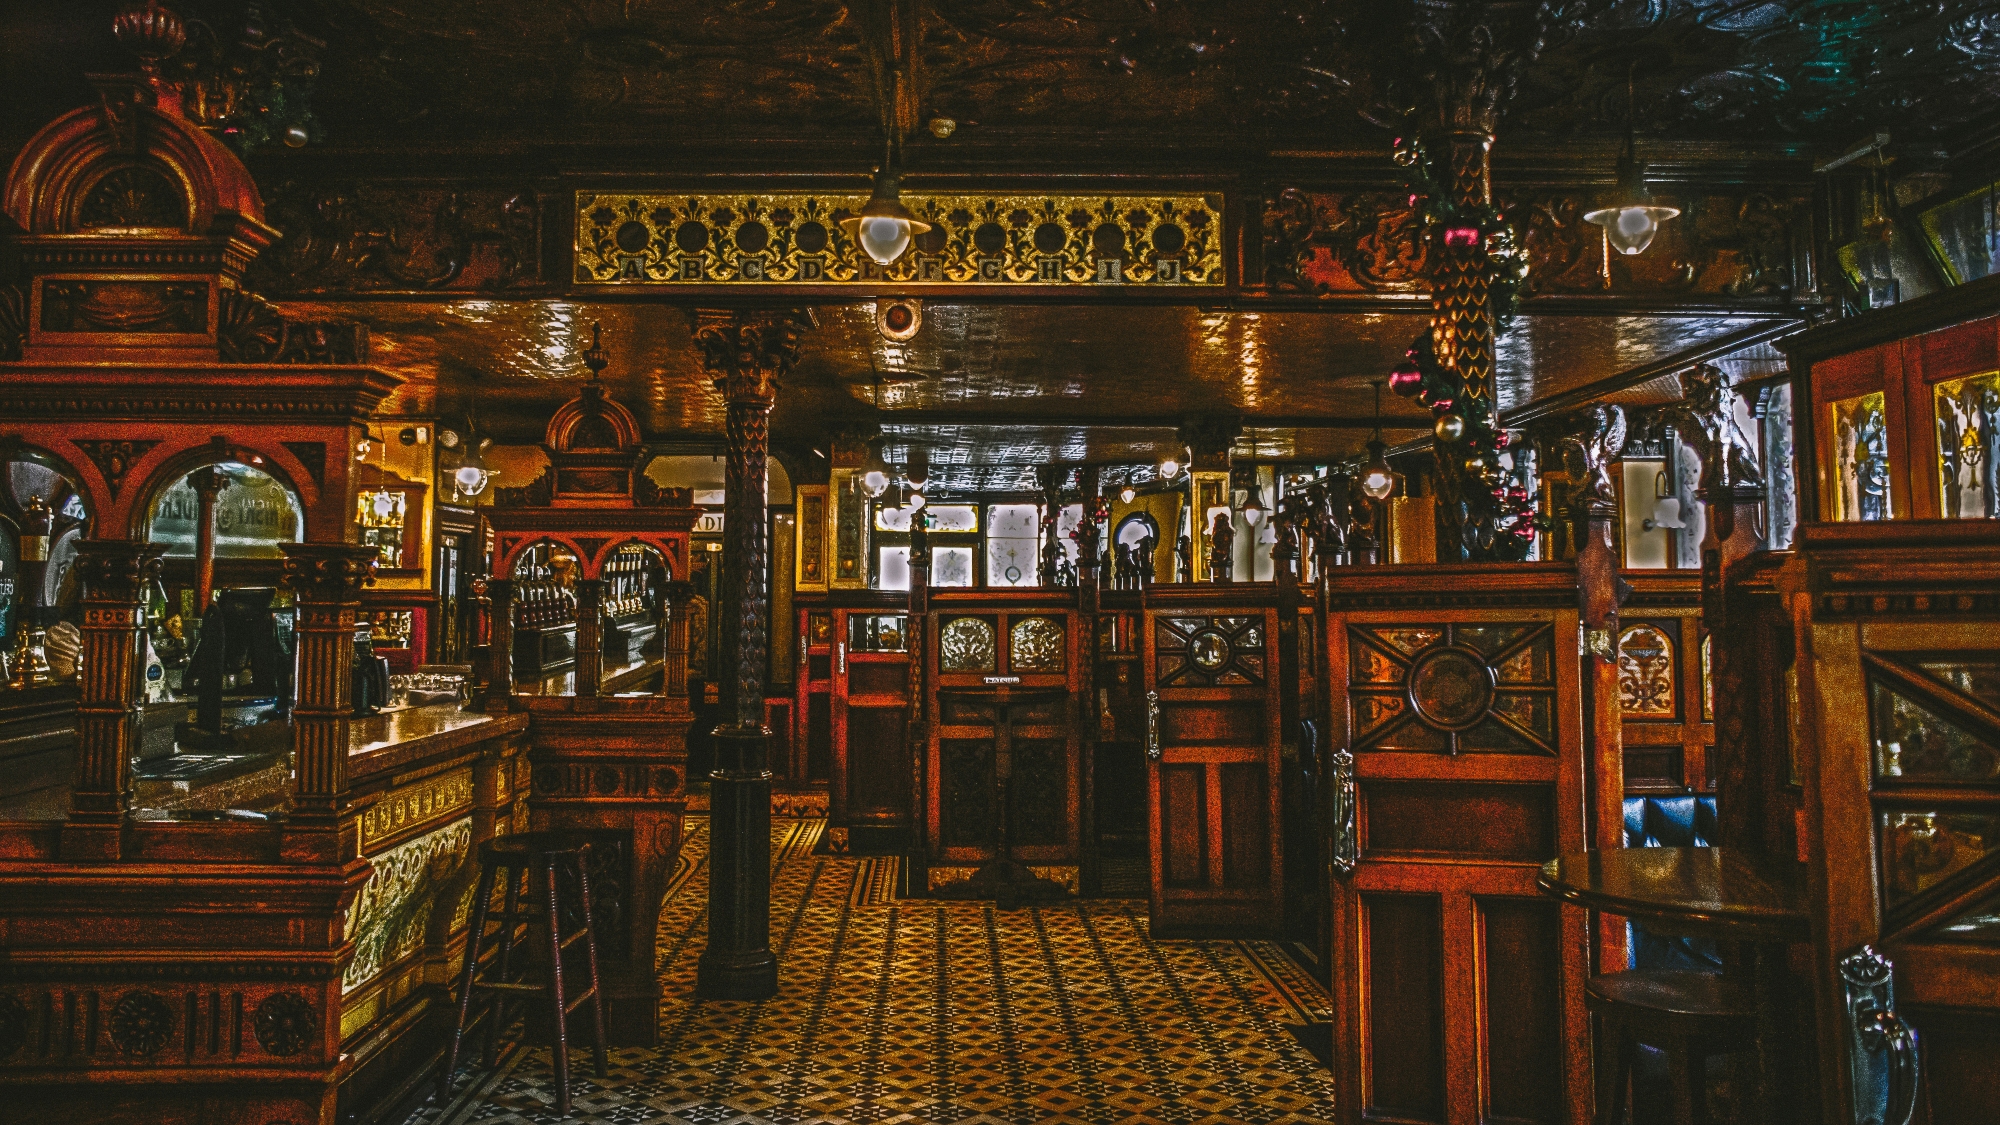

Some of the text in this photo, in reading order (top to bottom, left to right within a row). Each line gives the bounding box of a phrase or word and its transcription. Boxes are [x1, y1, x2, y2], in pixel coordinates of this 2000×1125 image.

[624, 261, 1175, 280] A B C D E F G H I J
